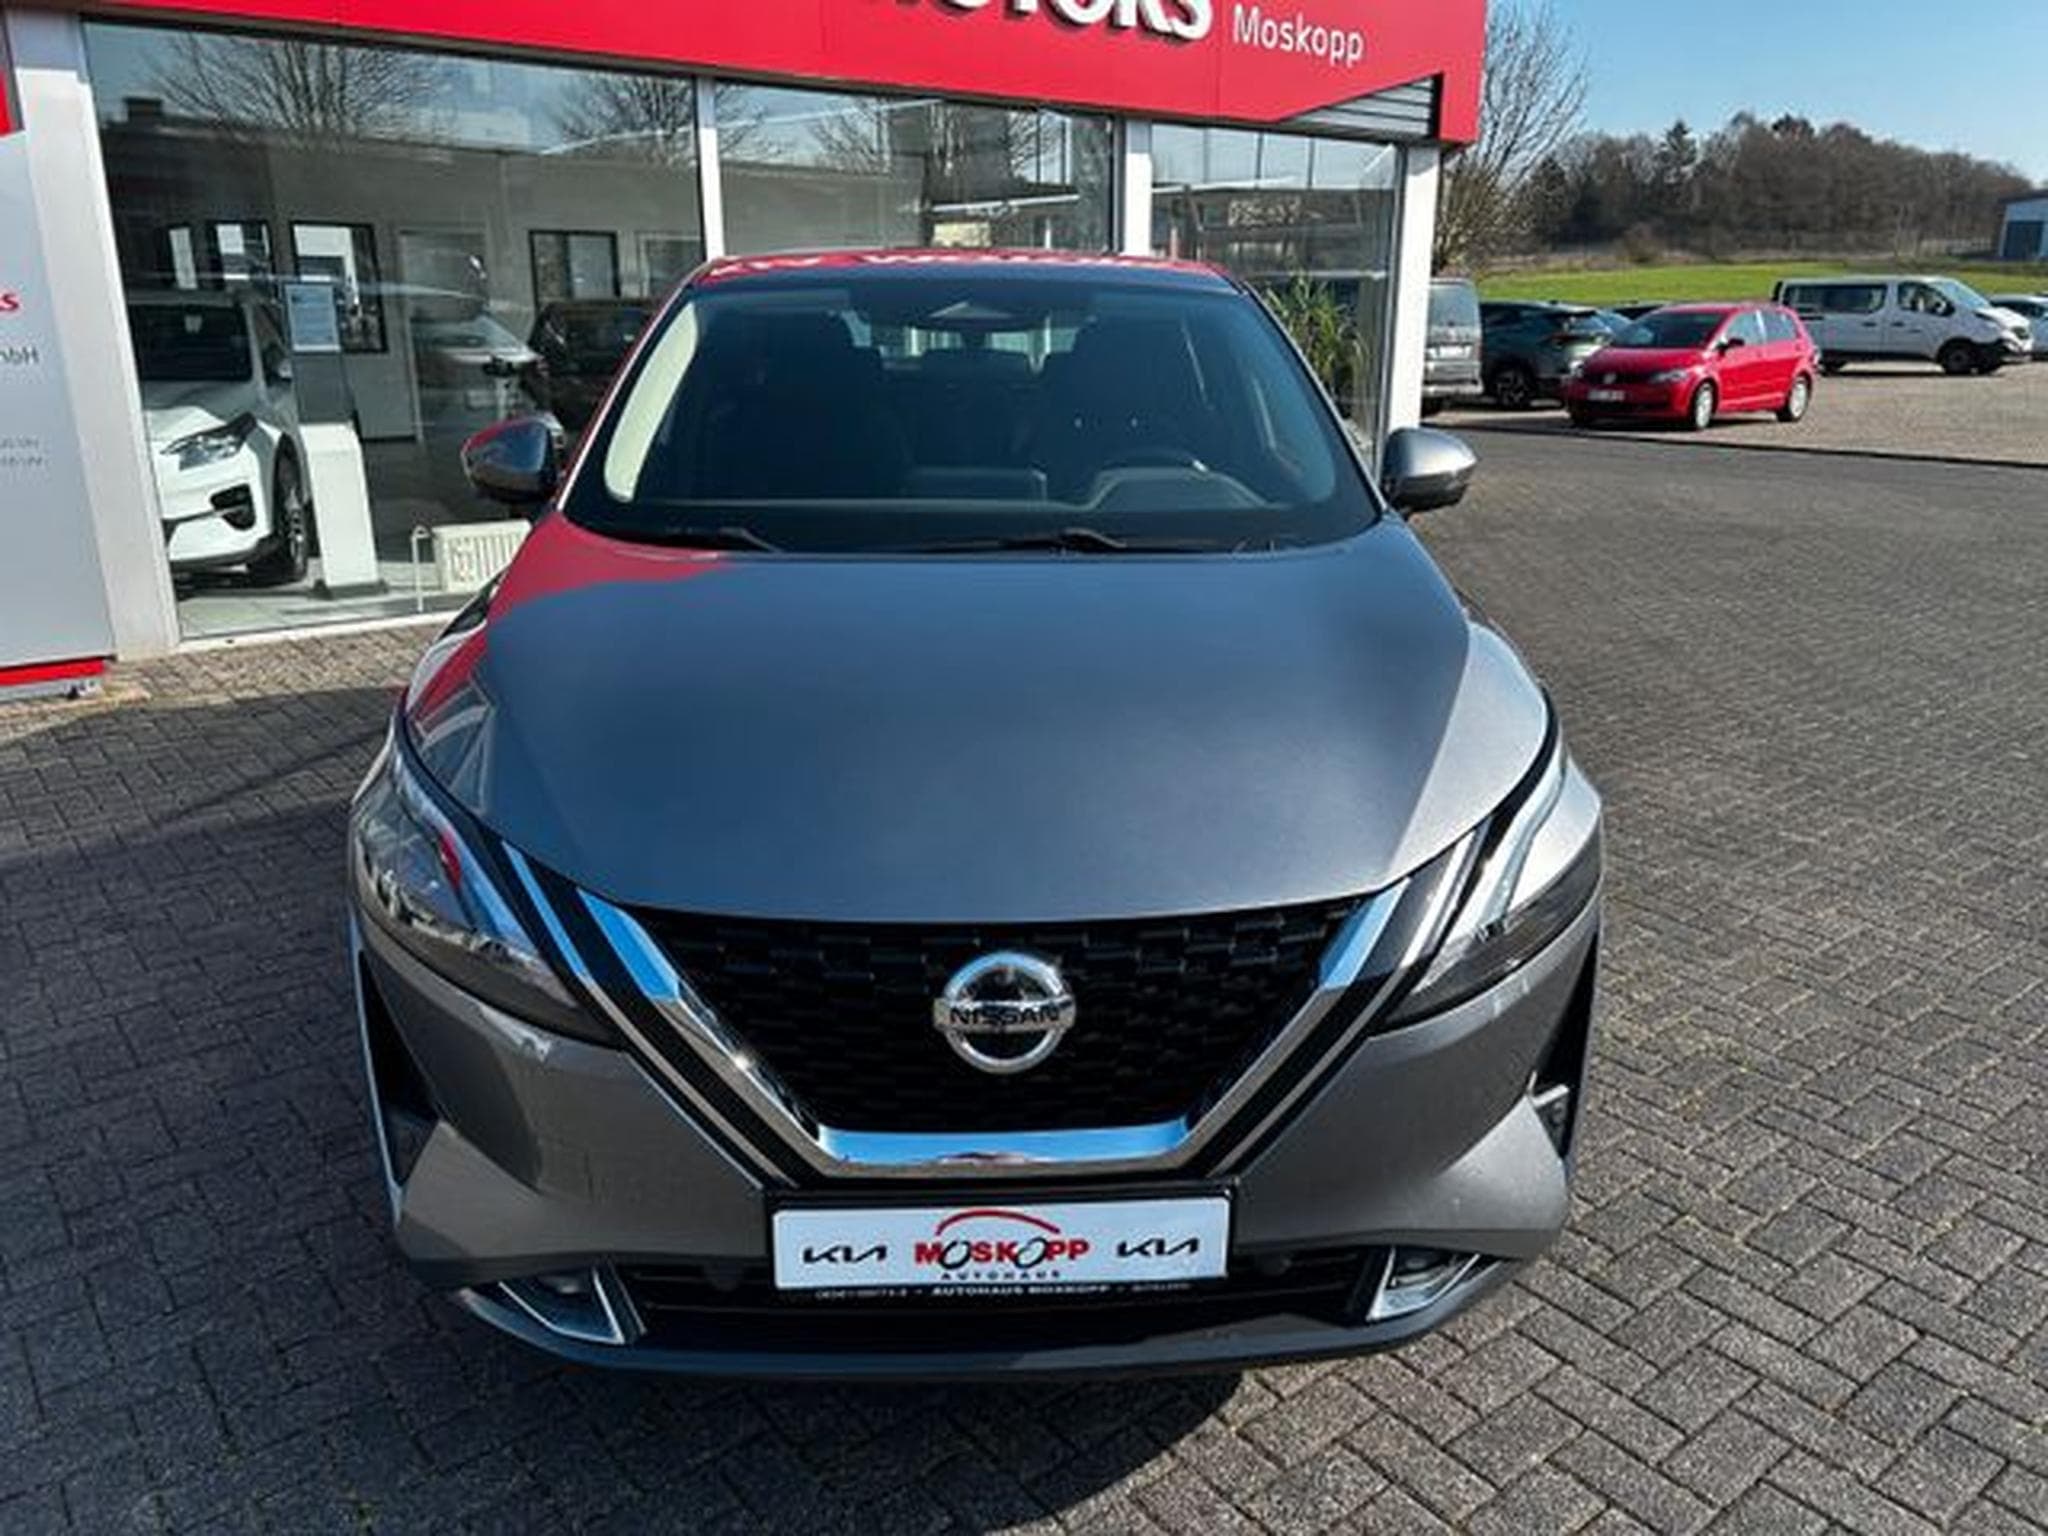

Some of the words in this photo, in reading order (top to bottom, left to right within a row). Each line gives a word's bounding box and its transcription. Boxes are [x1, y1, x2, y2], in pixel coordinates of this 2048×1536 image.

[1233, 3, 1364, 68] Moskopp
[950, 1004, 1060, 1026] NISSAN
[803, 1244, 887, 1264] KIA
[914, 1236, 1090, 1269] MOSKOPP
[1116, 1237, 1199, 1258] KIA
[940, 1269, 1061, 1281] AUTOHAUS
[931, 1285, 1024, 1297] AUTOHAUS
